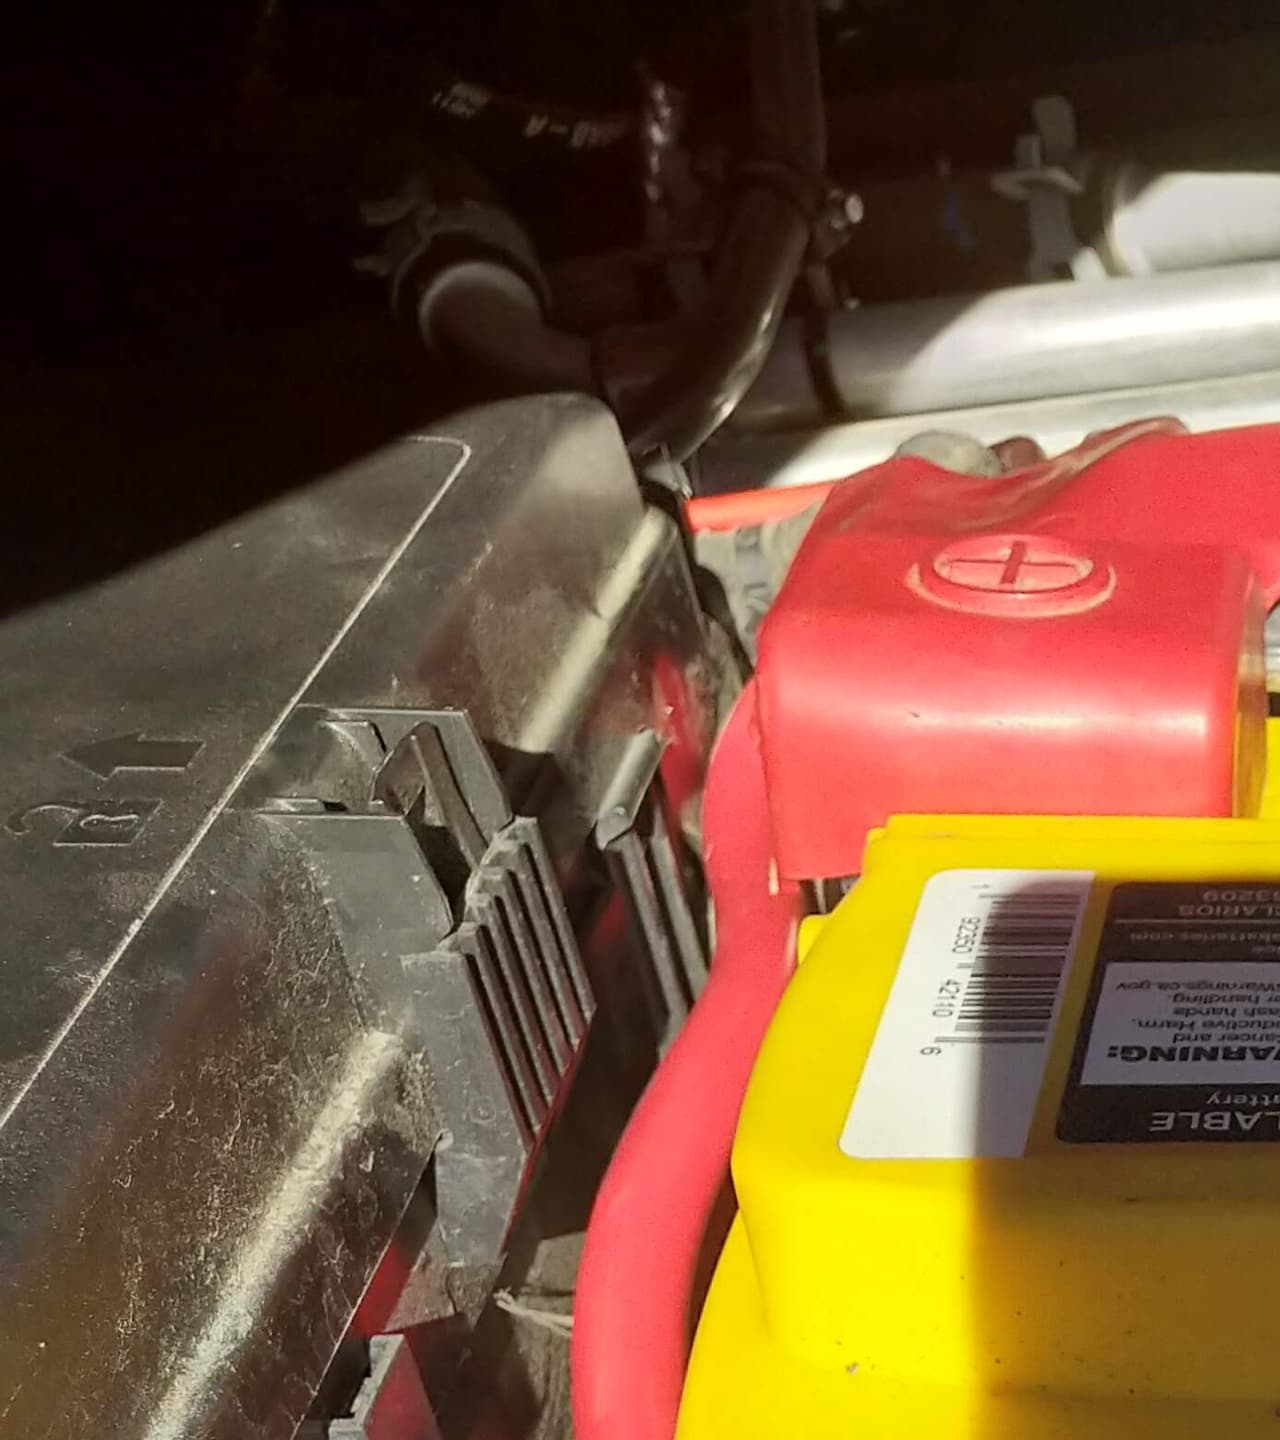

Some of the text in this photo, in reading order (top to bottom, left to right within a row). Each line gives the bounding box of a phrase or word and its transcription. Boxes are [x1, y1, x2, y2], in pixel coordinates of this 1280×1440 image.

[1172, 1006, 1237, 1019] hands
[1171, 1032, 1212, 1045] and
[919, 1045, 942, 1057] 6
